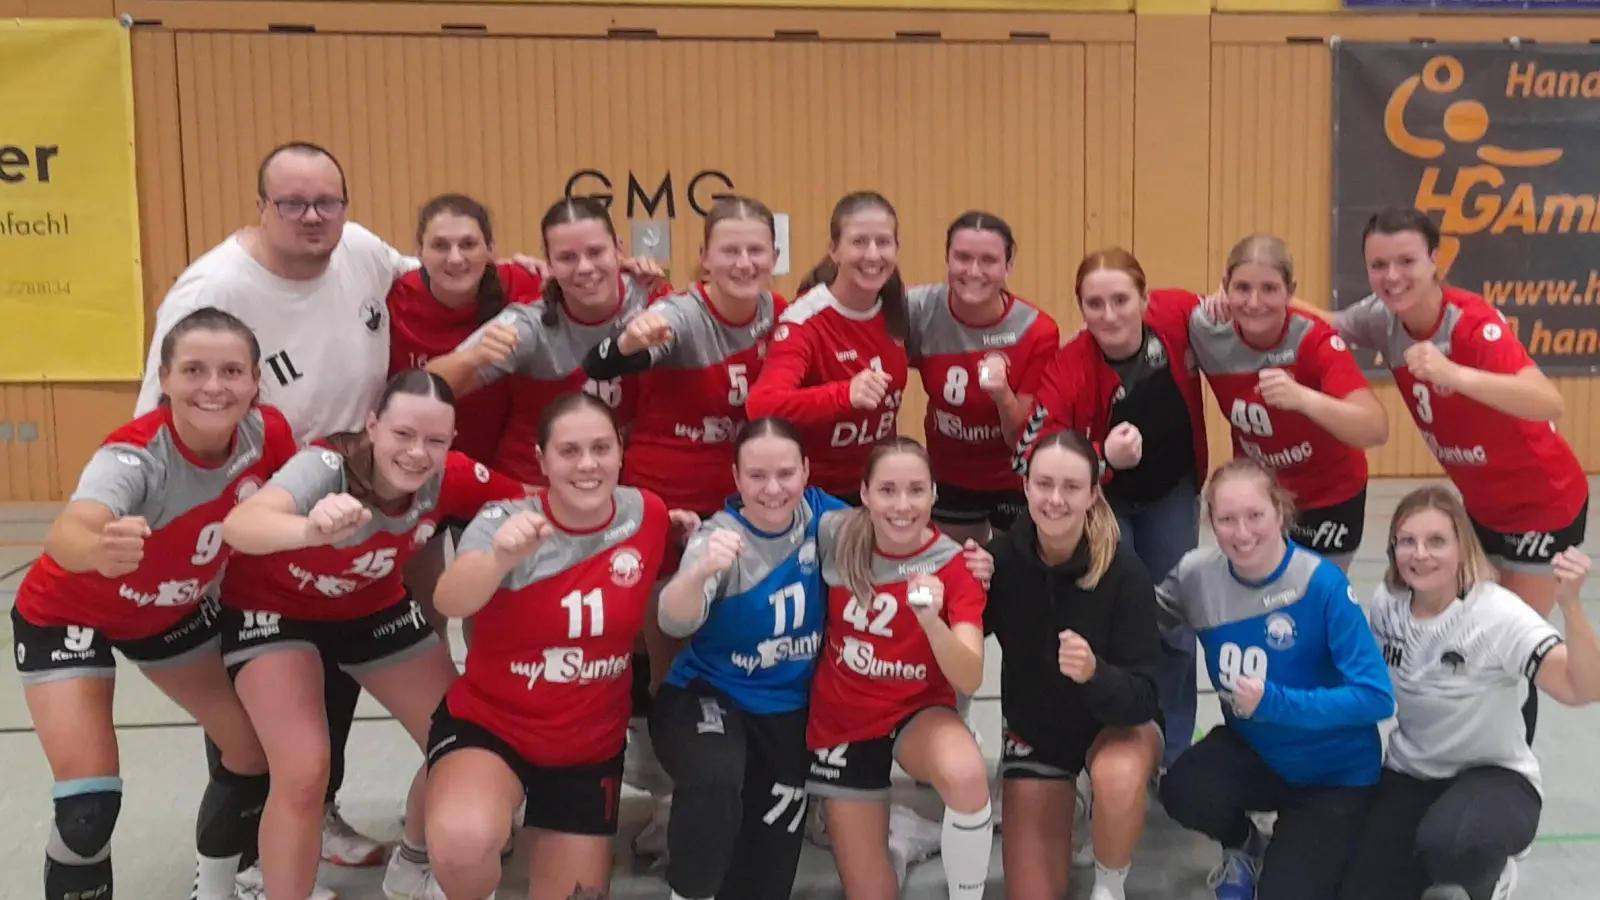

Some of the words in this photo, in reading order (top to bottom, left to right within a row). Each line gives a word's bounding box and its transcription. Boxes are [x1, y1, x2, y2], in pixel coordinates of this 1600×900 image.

[0, 145, 59, 183] er
[1415, 165, 1600, 235] HGAm
[1529, 318, 1600, 355] han
[265, 349, 304, 387] TL
[728, 363, 748, 407] 5
[943, 365, 969, 407] 8
[1231, 398, 1273, 437] 49
[1412, 383, 1433, 424] 3
[191, 521, 223, 566] 9
[1312, 520, 1349, 548] fit
[352, 547, 398, 580] 15
[561, 587, 604, 639] 11
[842, 592, 898, 638] 42
[762, 782, 808, 833] 77
